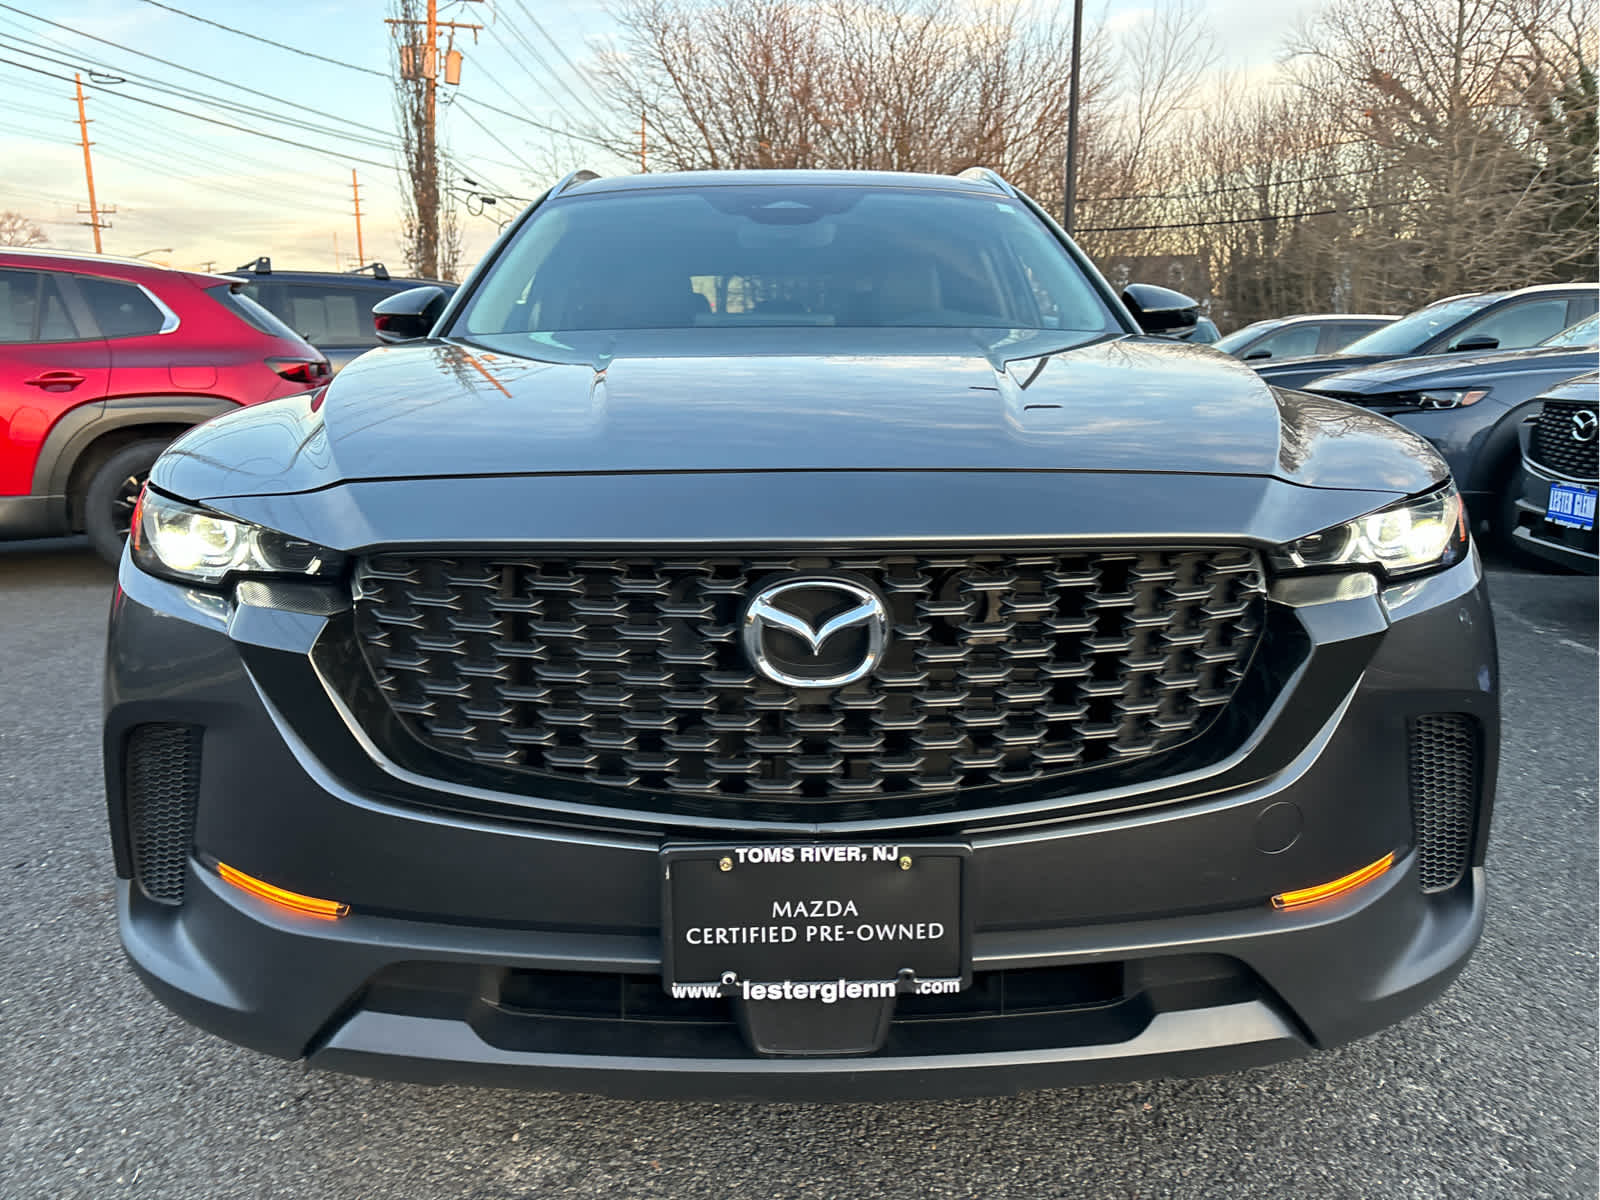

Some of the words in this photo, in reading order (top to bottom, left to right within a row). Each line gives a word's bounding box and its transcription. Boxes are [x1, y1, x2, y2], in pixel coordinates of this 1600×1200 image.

[735, 848, 795, 863] TOMS
[800, 847, 867, 862] RIVER,
[873, 846, 899, 861] NJ
[772, 900, 859, 918] MAZDA
[686, 926, 797, 944] CERTIFIED
[806, 922, 944, 942] PRE-OWNED
[743, 980, 896, 1003] lesterglenn
